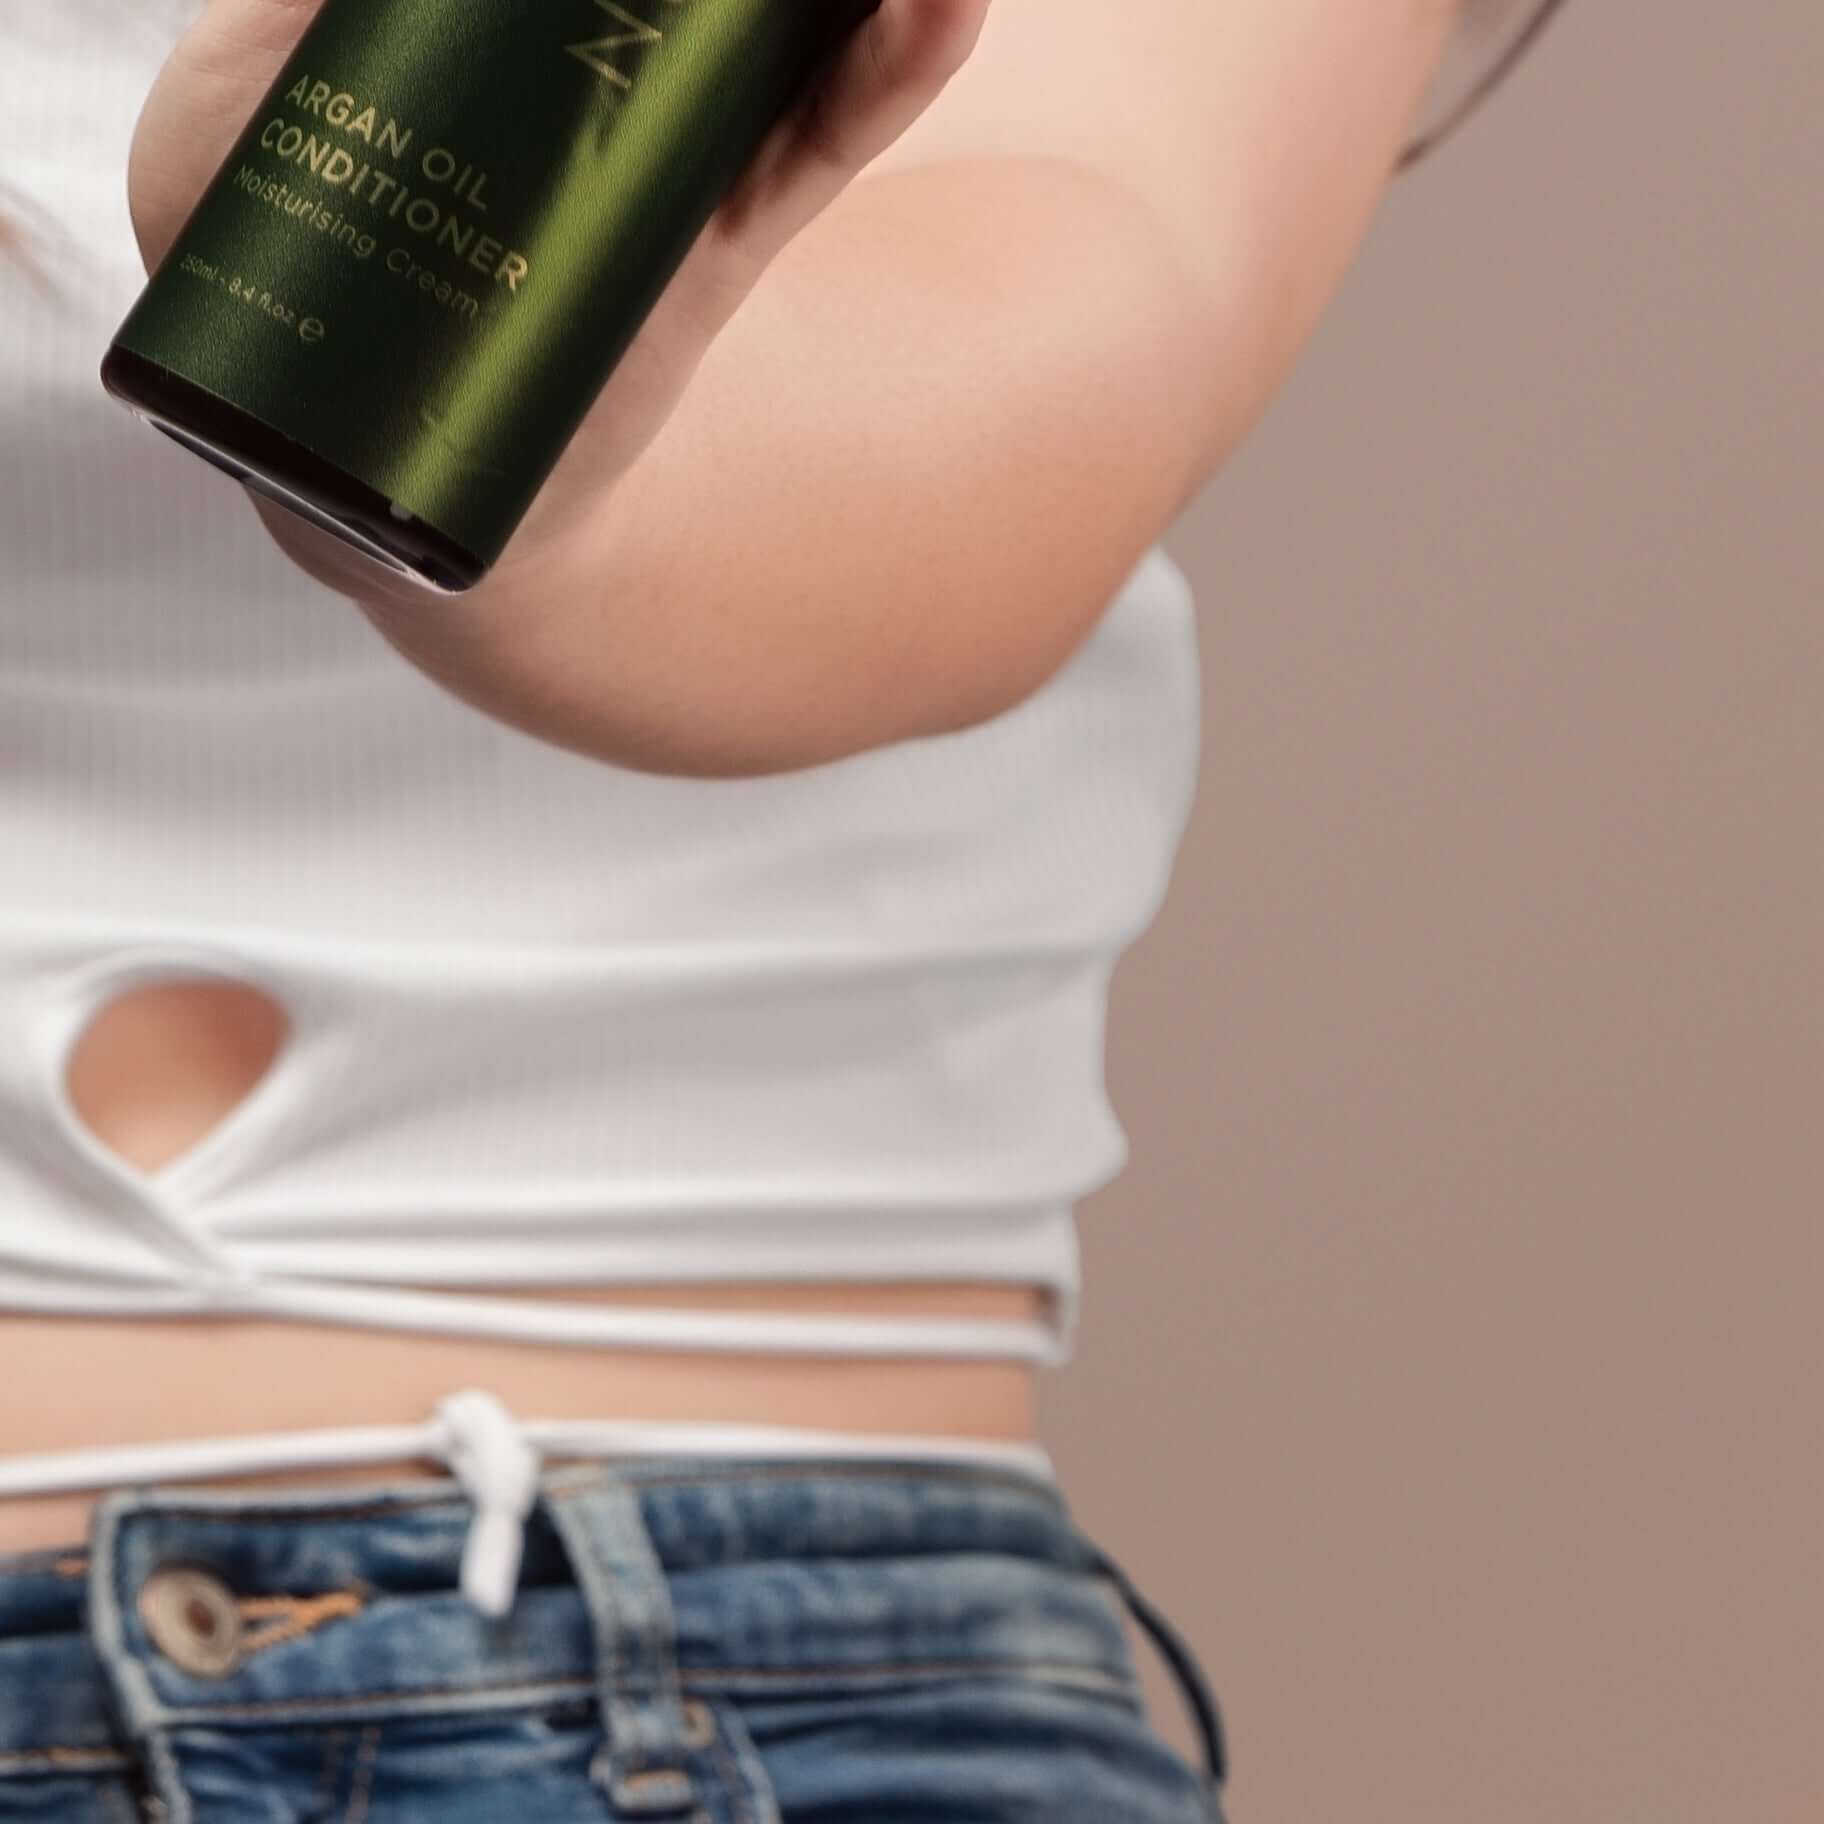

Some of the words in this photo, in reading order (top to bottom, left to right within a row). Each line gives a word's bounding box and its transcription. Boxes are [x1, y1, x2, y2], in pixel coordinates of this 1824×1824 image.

[259, 117, 529, 293] CONDITIONER
[284, 74, 414, 160] ARGAN
[421, 147, 489, 212] OIL
[232, 163, 377, 259] Moisturising
[385, 247, 479, 319] Cream
